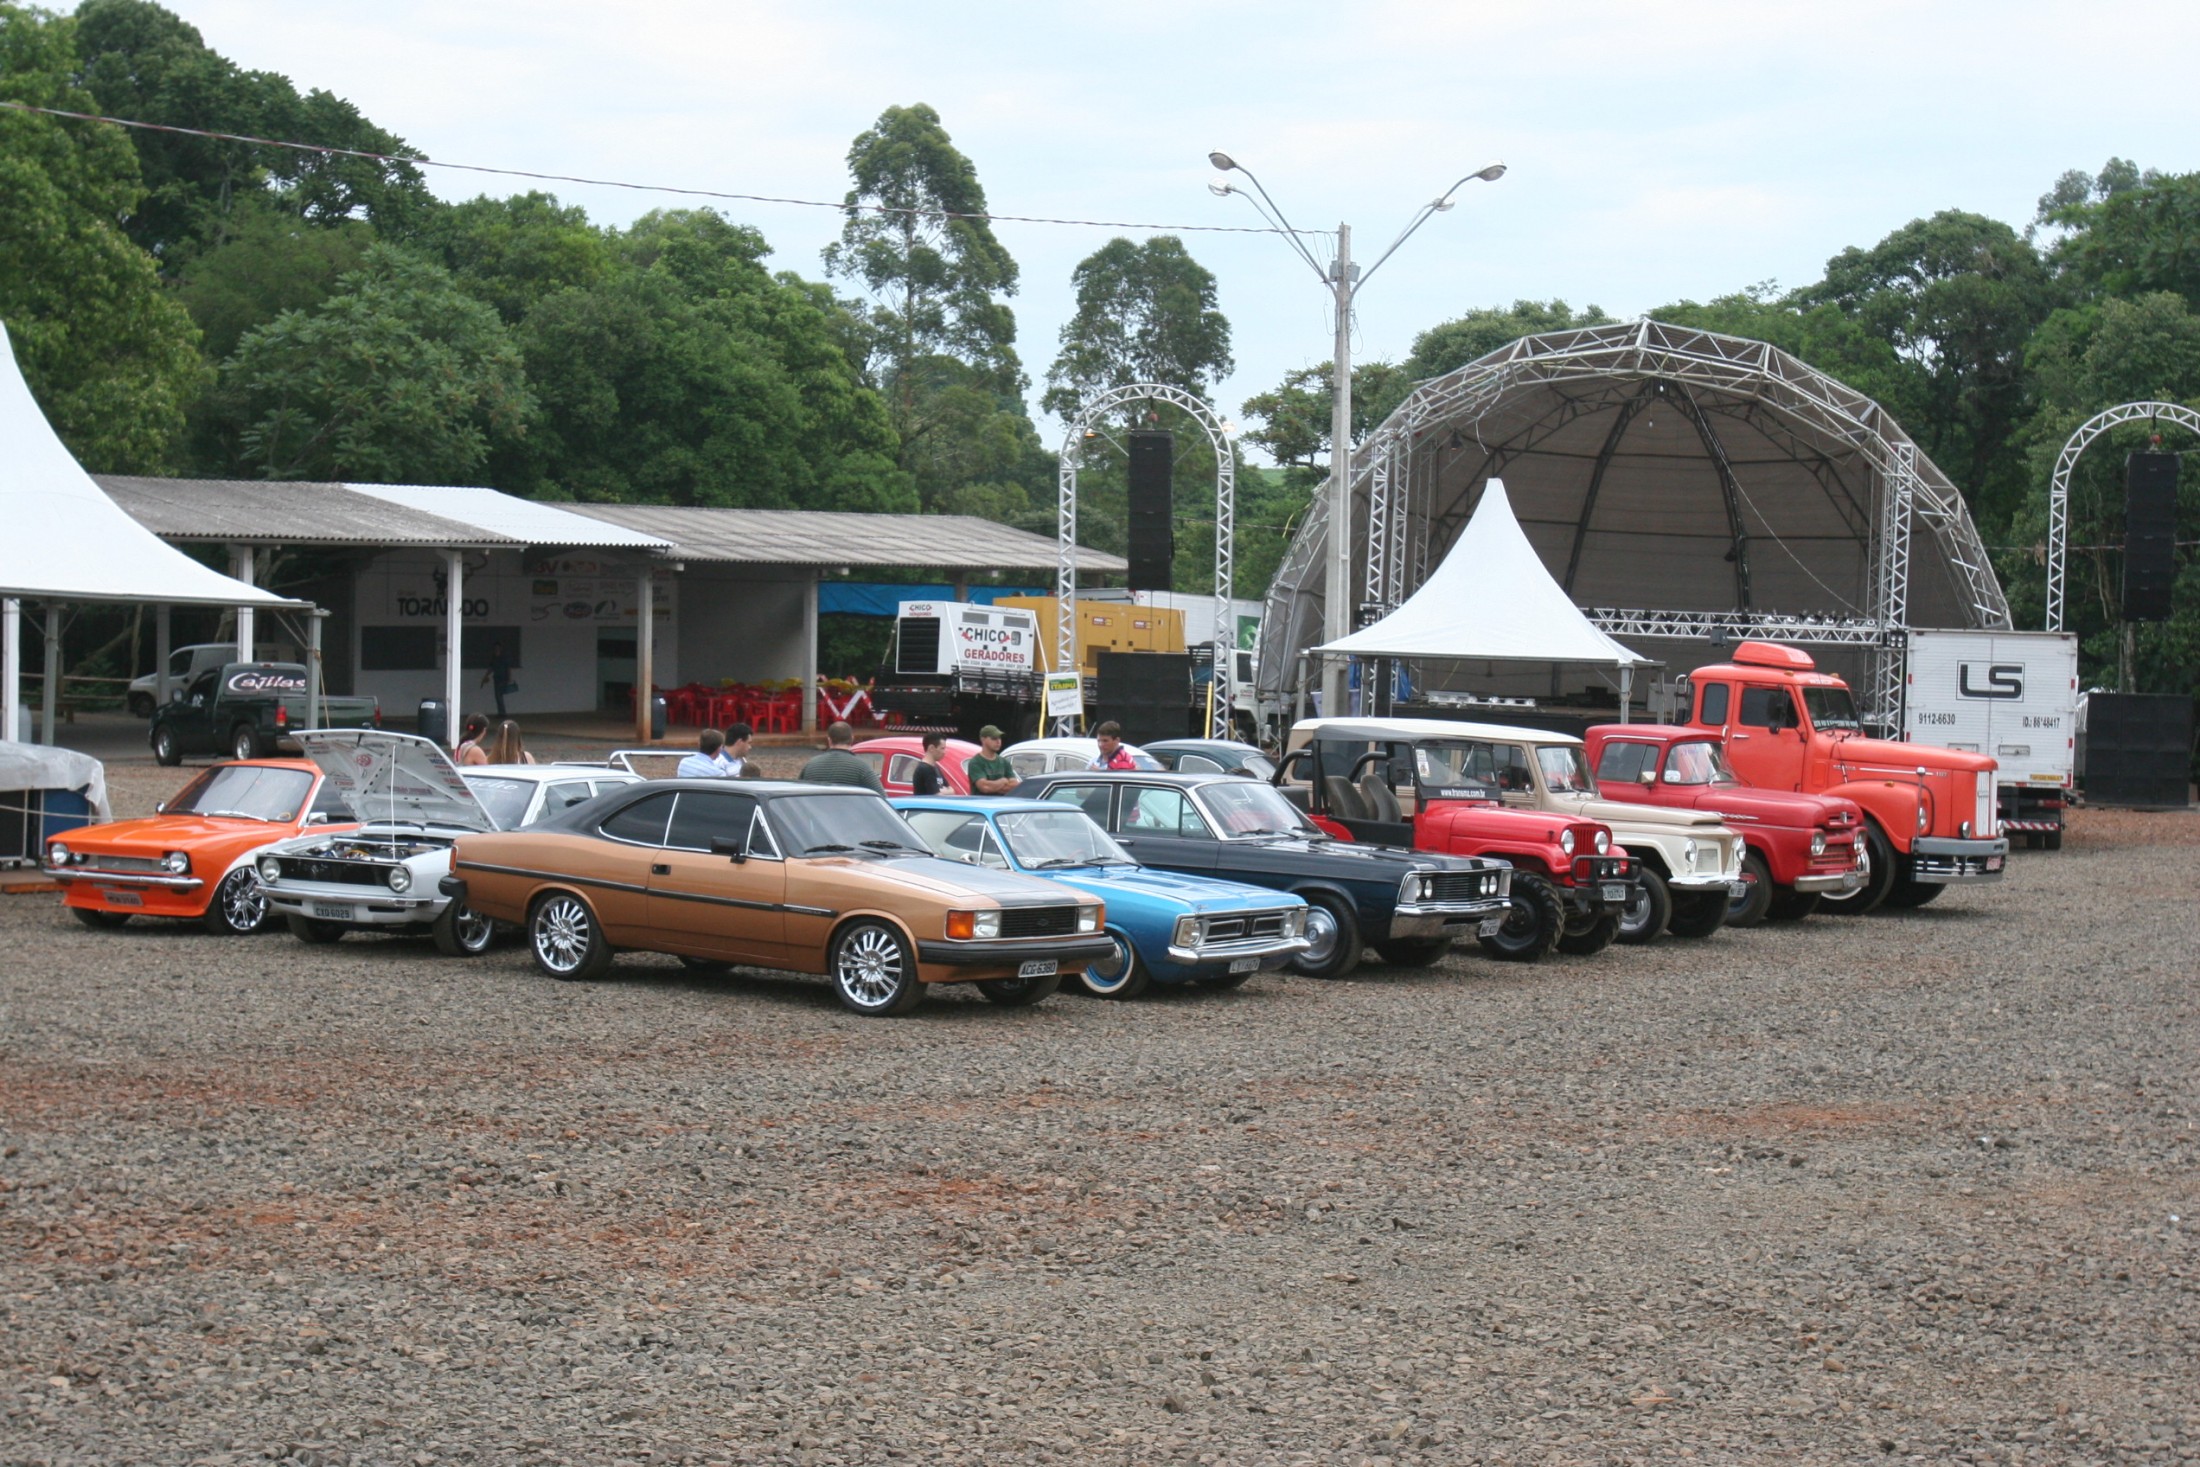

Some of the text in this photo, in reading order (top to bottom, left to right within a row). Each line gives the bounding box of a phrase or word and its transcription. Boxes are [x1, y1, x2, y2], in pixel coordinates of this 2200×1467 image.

[397, 597, 490, 617] TORNDO
[965, 627, 1008, 642] CHICO
[964, 648, 1025, 664] GERADORES
[1959, 664, 2023, 699] LS
[1918, 712, 1956, 725] 9112-6630
